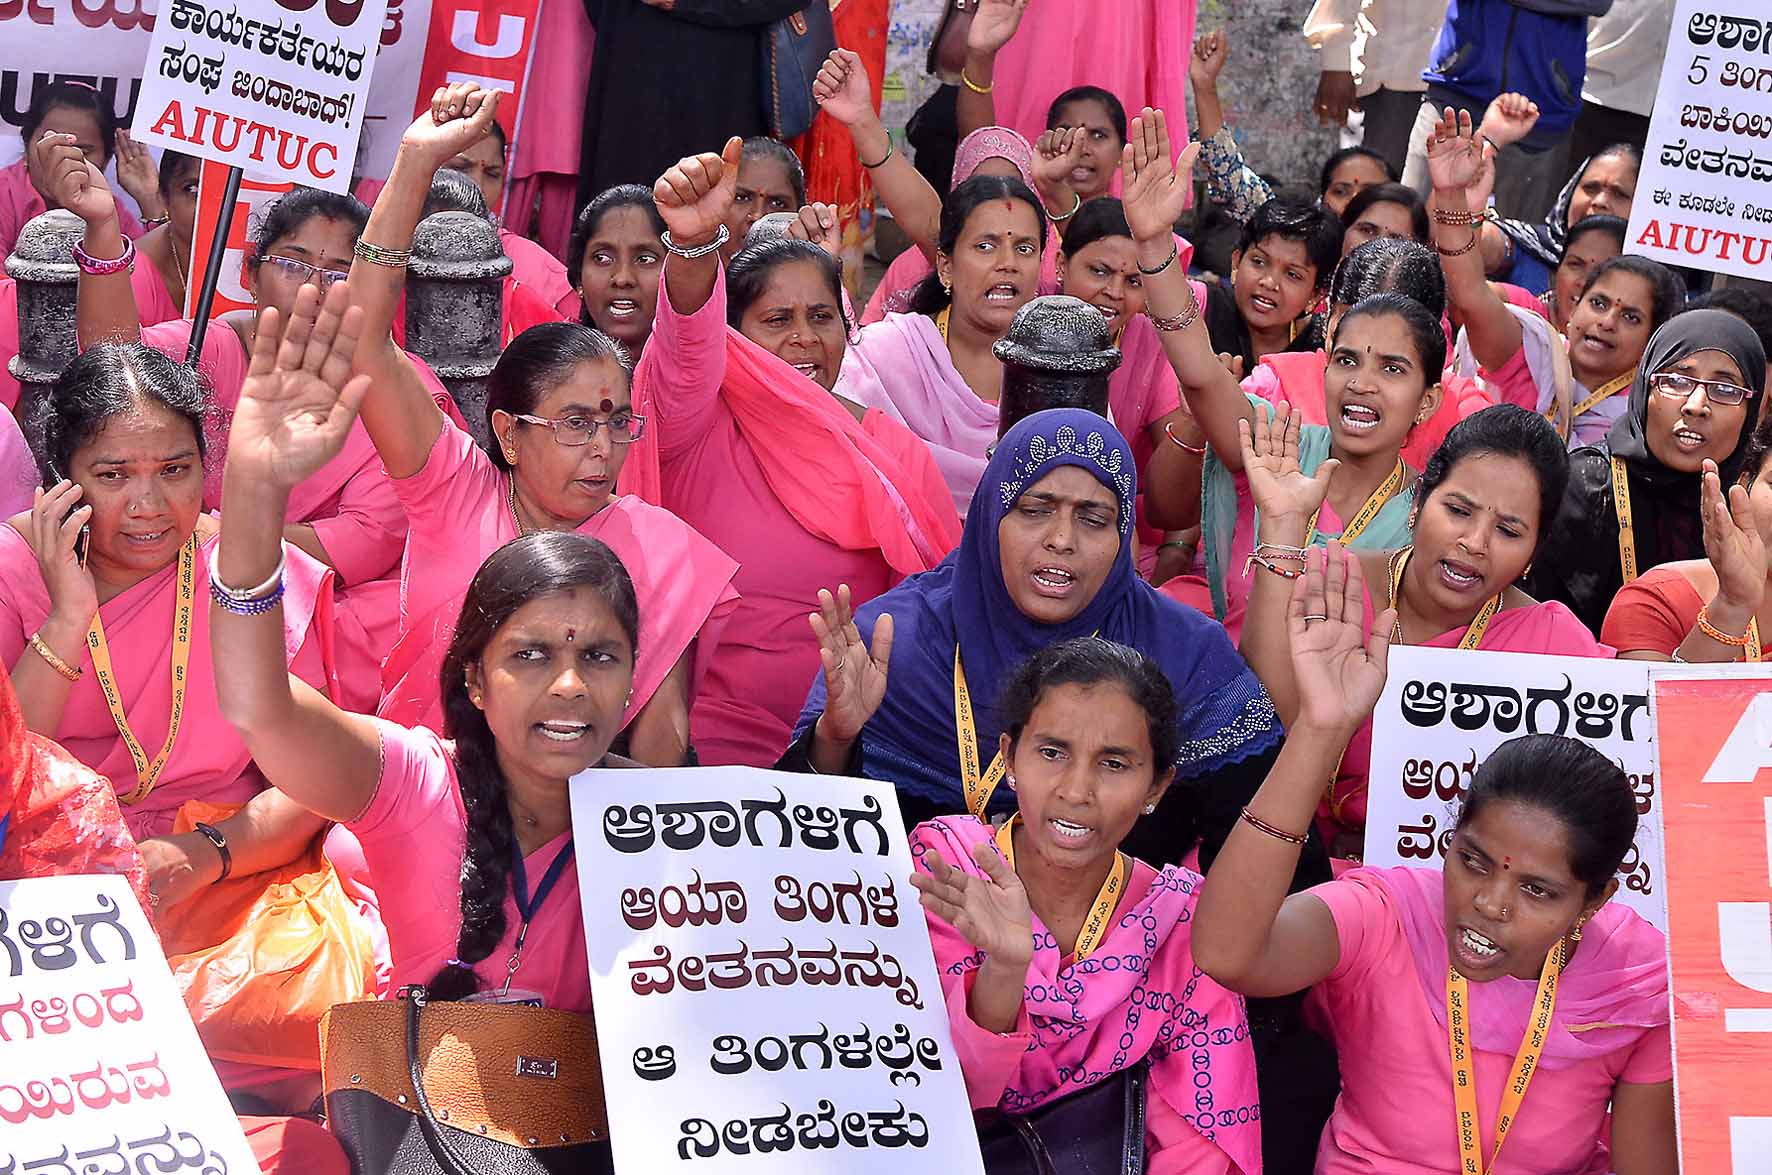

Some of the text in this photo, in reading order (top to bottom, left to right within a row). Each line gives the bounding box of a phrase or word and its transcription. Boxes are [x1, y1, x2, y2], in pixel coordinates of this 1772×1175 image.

[160, 40, 225, 95] ಸಂಘ
[1688, 55, 1711, 85] 5
[151, 100, 338, 179] AIUTUC
[1653, 187, 1672, 206] ಈ
[1679, 192, 1735, 216] ಕೂಡಲೇ
[1636, 219, 1772, 265] AIUTU
[603, 786, 889, 856] ಆಶಾಗಳಿಗೆ
[621, 868, 900, 931] ಆಯಾ ತಿಂಗಳ
[628, 937, 924, 1010] ವೇತನವನ್ನು
[633, 1021, 942, 1087] ಆ ತಿಂಗಳಲ್ಲೇ
[677, 1098, 930, 1160] ನೀಡಬೇಕು
